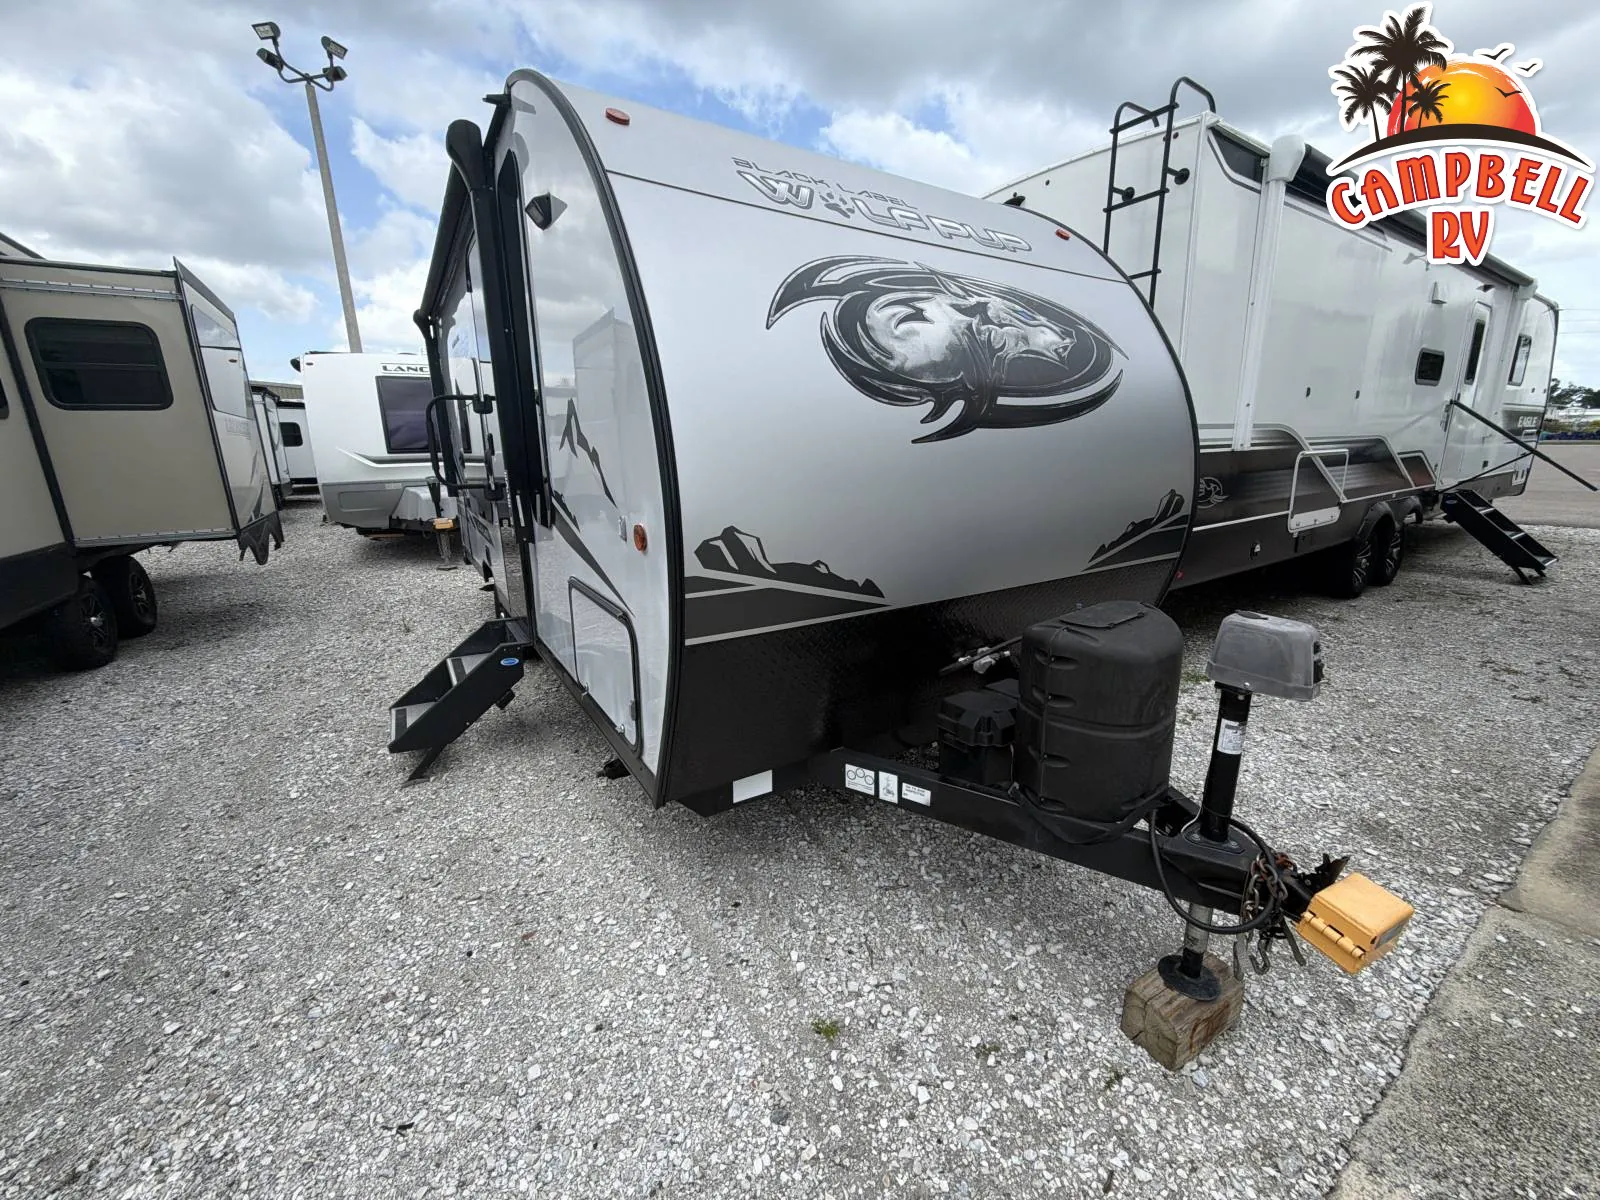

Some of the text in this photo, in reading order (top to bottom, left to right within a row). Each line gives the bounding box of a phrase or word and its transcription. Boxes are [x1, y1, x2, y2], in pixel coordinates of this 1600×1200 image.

[731, 157, 918, 210] BLACK LABEL
[926, 214, 1032, 252] PUP
